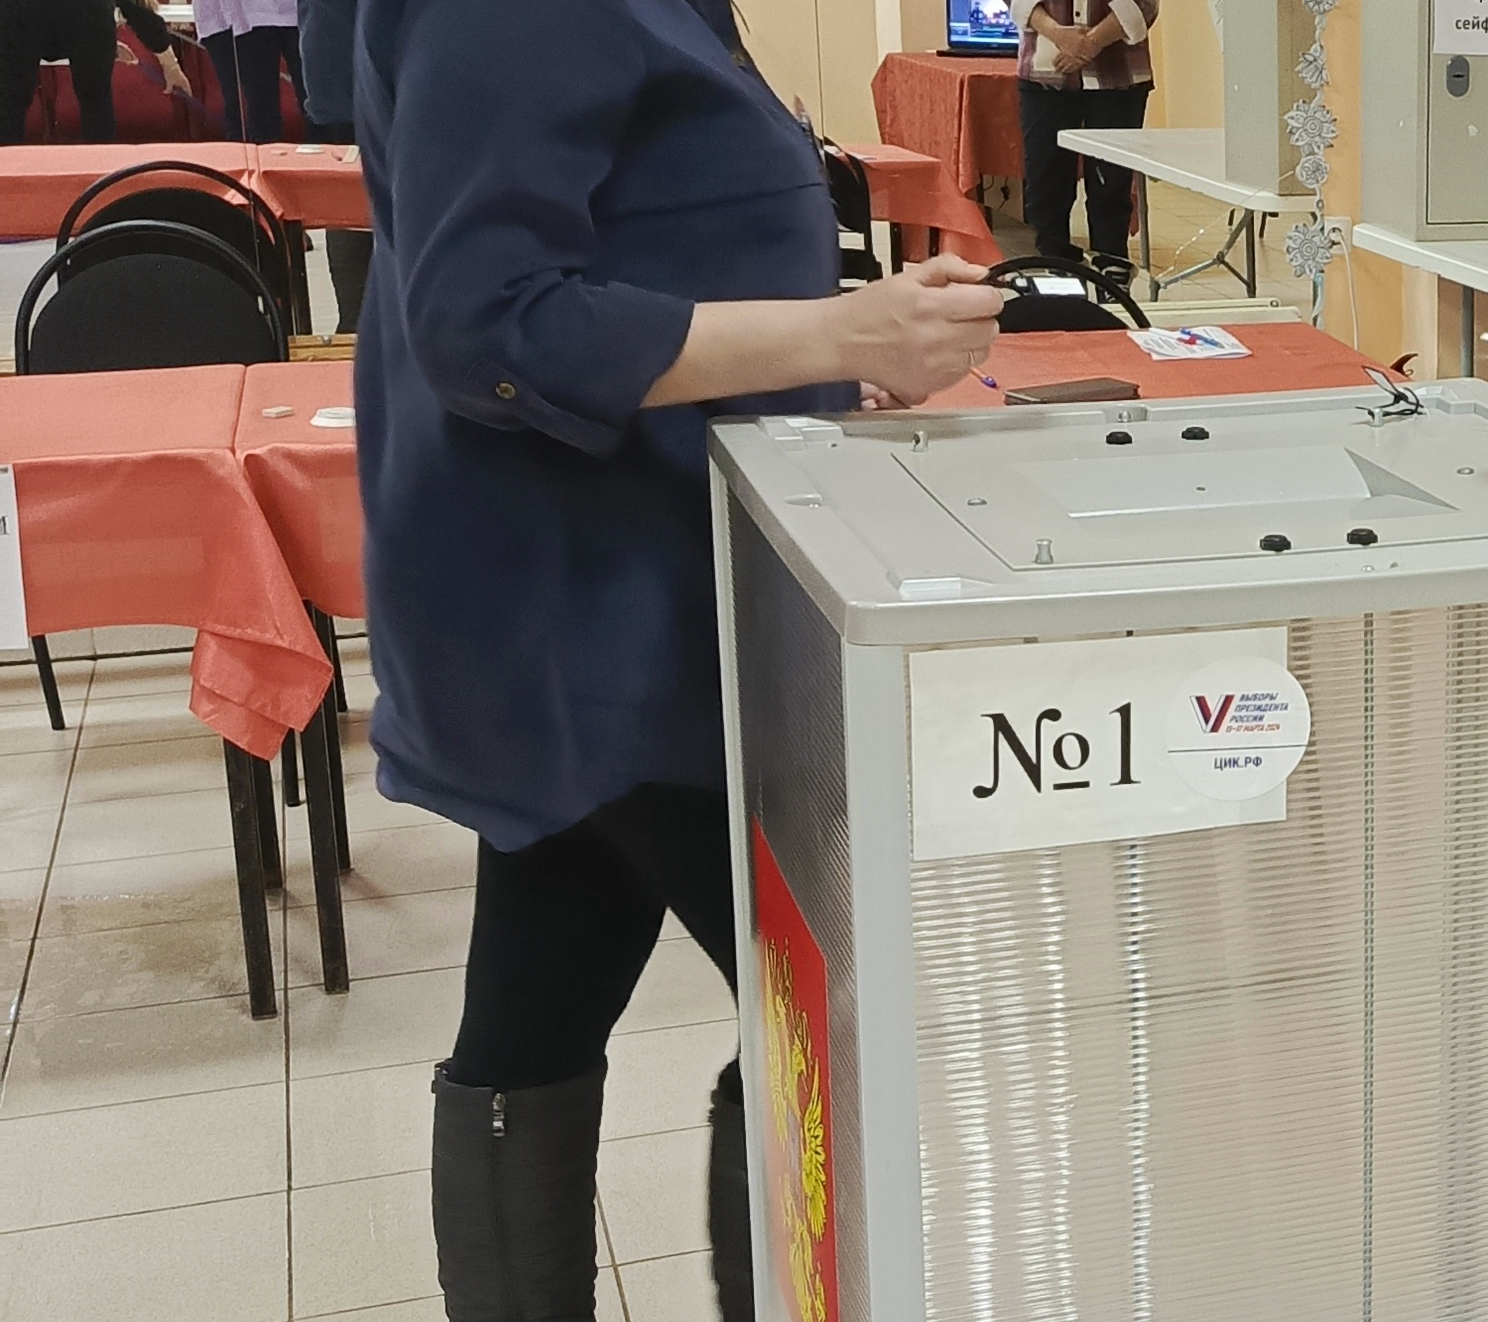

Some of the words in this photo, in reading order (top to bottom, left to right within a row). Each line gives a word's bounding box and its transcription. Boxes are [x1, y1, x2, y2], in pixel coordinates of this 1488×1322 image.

[1239, 692, 1279, 702] ВЫБОРЫ
[1234, 702, 1289, 713] ПРЕЗИДЕНТА
[1229, 714, 1265, 723] РОССИИ
[1214, 756, 1263, 771] ЦИК.РФ
